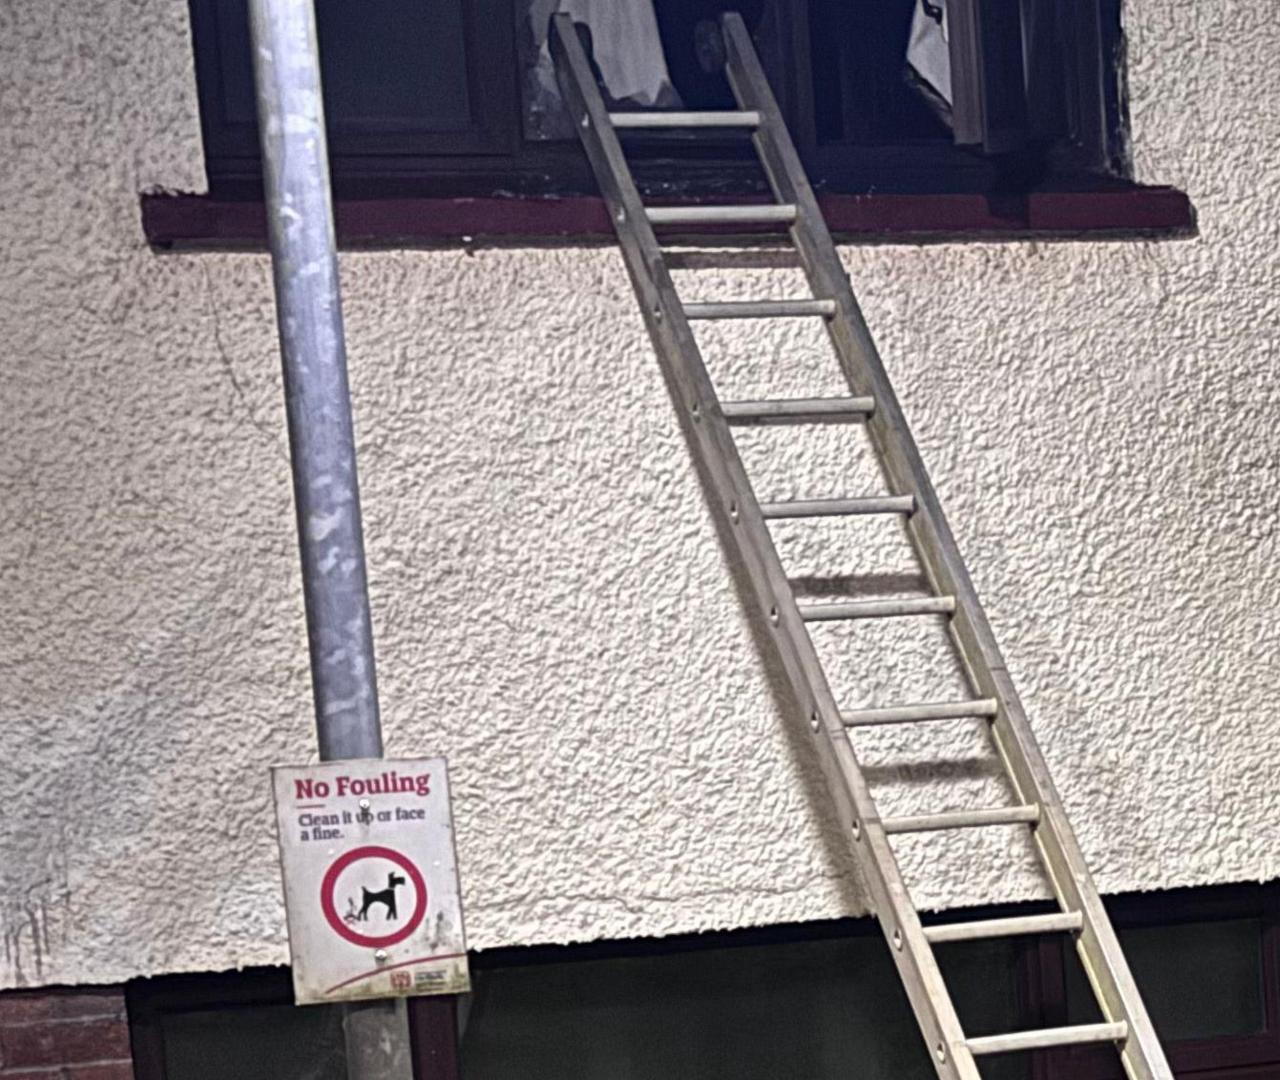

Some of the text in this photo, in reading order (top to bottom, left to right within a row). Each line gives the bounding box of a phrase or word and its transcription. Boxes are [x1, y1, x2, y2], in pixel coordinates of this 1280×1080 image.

[294, 771, 431, 799] No Fouling
[298, 806, 426, 827] Clean it up or face
[300, 826, 345, 841] a fine.
